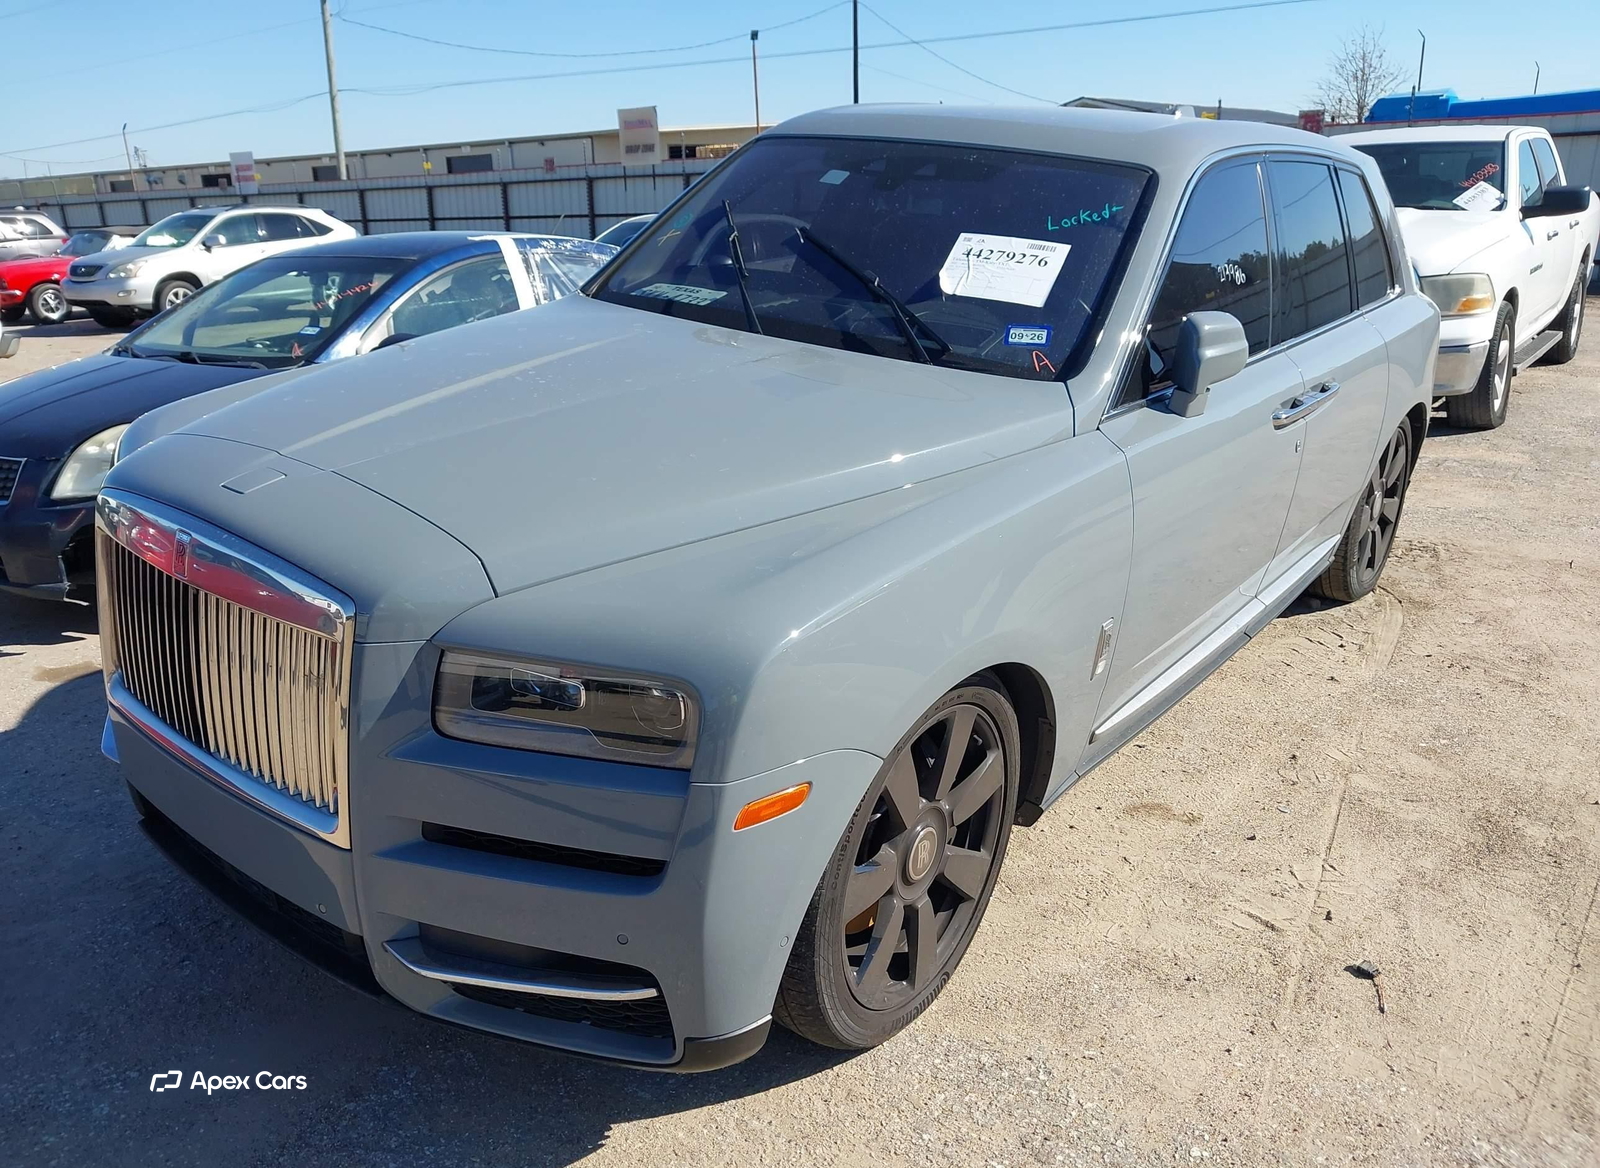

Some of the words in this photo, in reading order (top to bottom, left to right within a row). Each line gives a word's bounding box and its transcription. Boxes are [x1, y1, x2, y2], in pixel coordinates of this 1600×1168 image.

[962, 247, 1051, 268] 44279276
[672, 286, 702, 294] TEXAS
[1010, 332, 1024, 340] 09
[1029, 332, 1044, 341] 26
[1032, 350, 1056, 373] A
